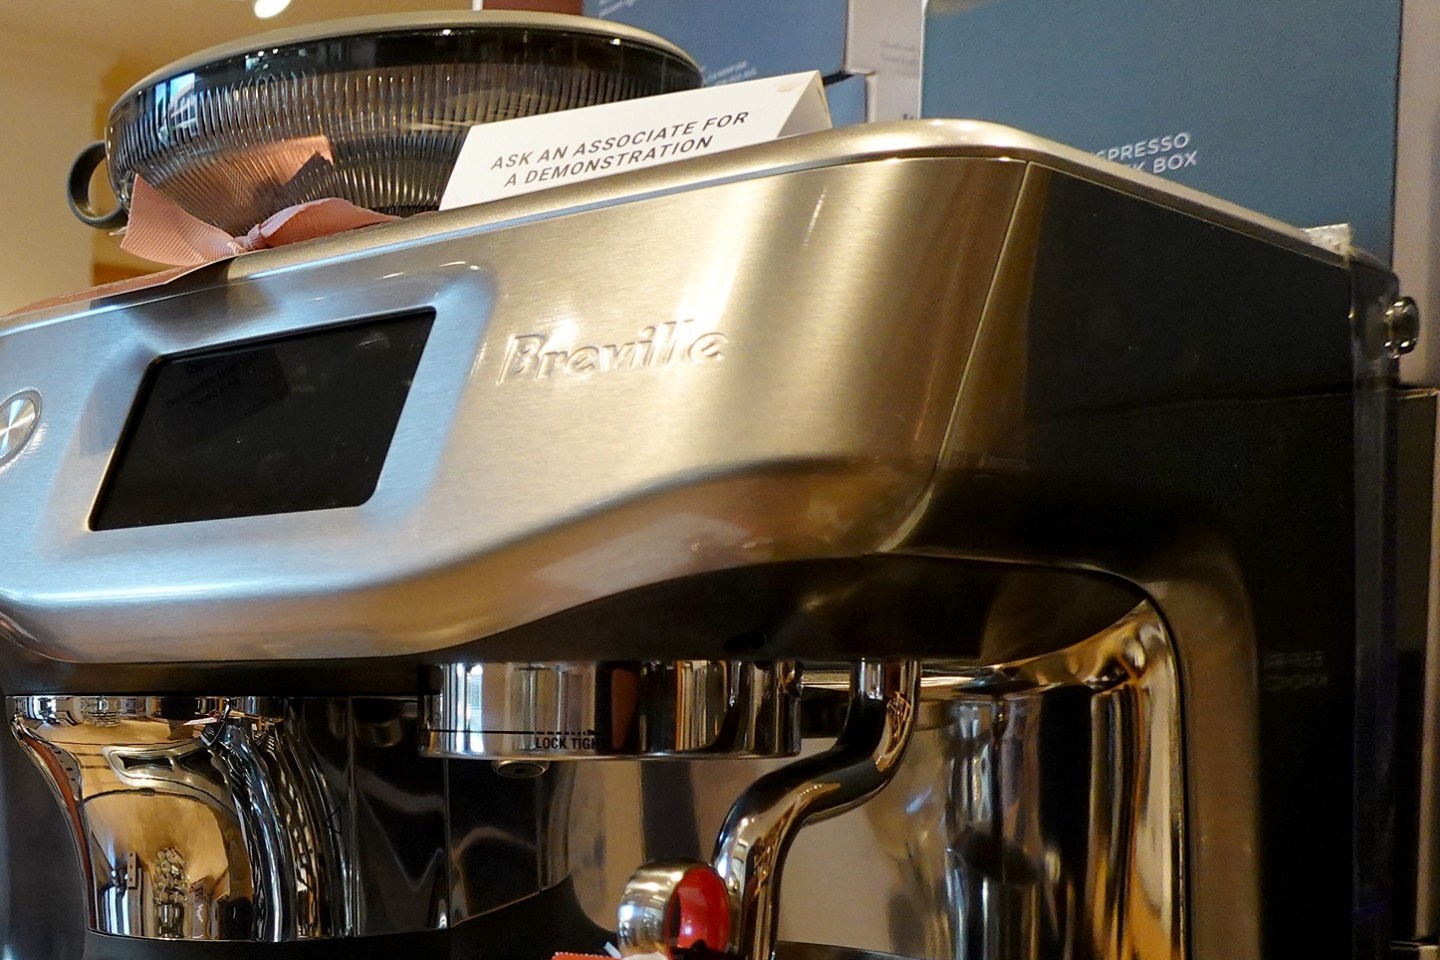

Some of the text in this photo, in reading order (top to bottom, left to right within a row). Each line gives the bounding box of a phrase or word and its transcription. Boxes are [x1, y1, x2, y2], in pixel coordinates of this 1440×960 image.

[490, 111, 749, 171] ASK AN ASSOCIATE FOR
[504, 135, 713, 187] A DEMONSTRATION
[1096, 131, 1190, 160] PRESSO
[1153, 150, 1198, 174] BOX
[497, 319, 728, 385] Breville
[535, 737, 603, 750] LOCK TIGH
